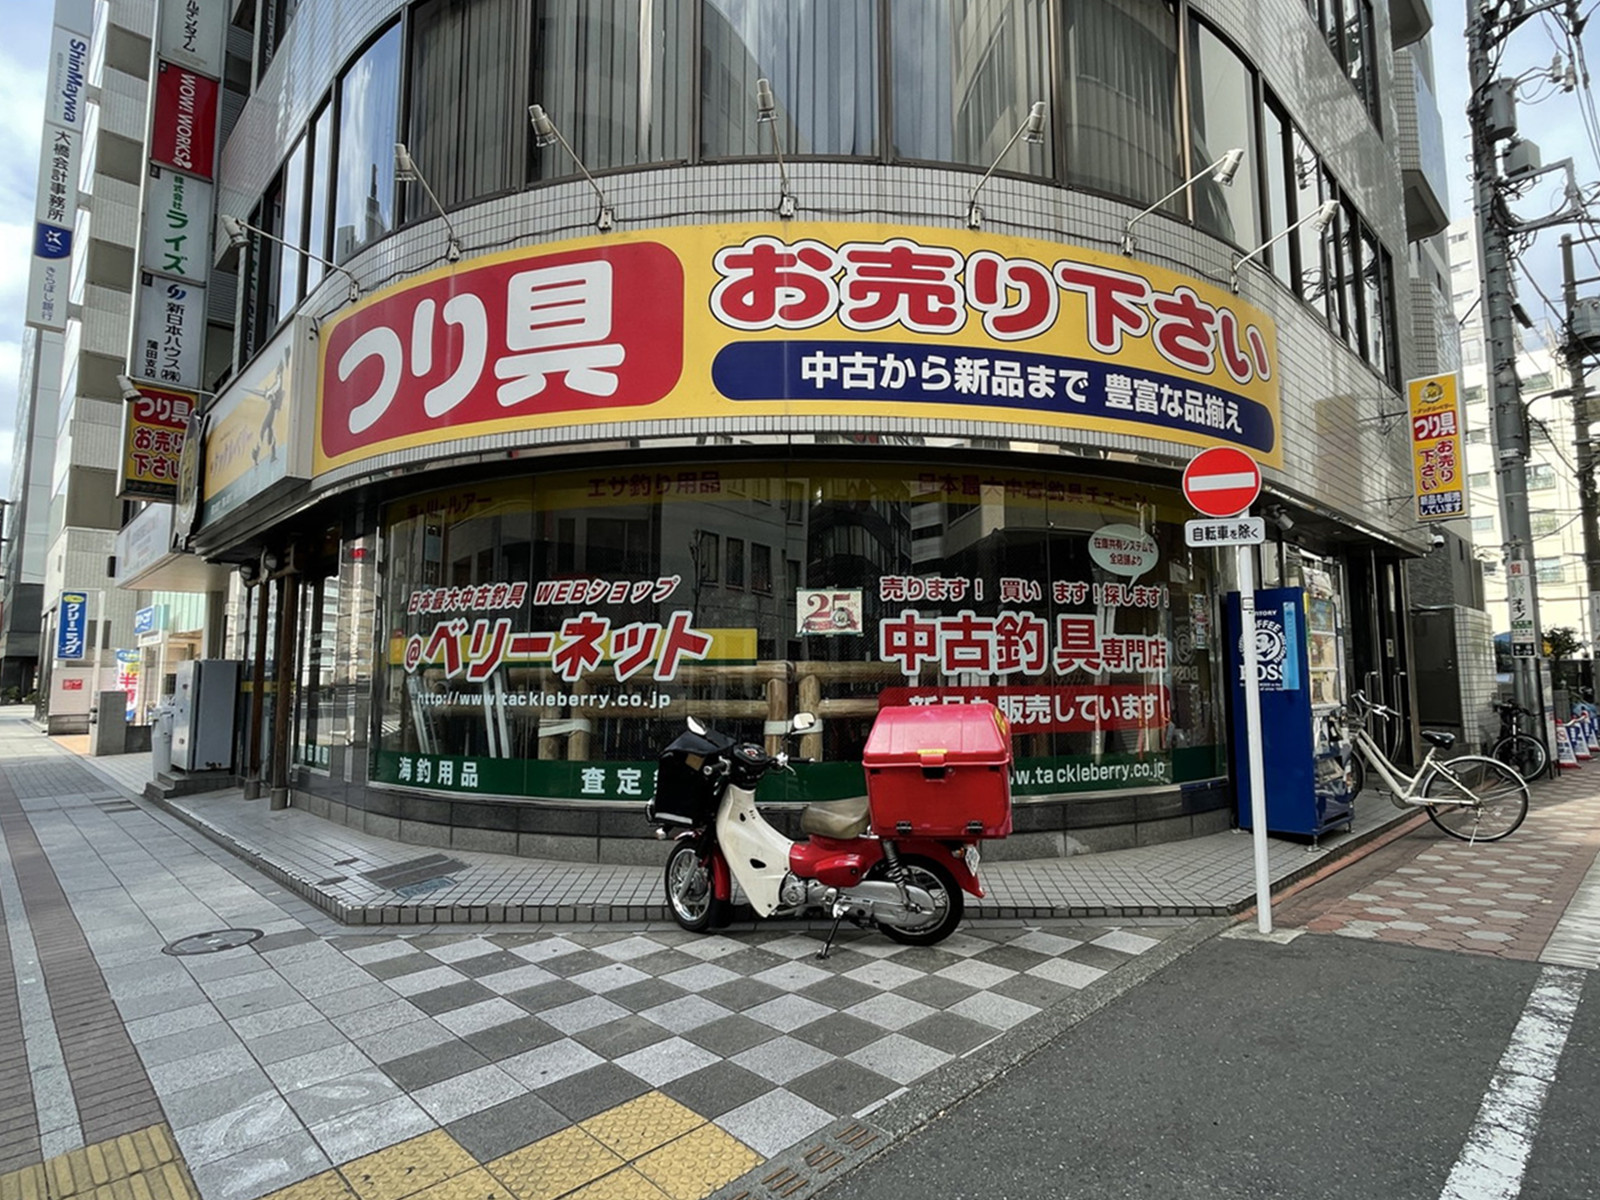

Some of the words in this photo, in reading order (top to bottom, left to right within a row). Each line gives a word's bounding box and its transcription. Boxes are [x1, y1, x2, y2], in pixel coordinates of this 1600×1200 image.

[62, 39, 87, 123] ShinMaywa
[178, 73, 197, 113] WOW!
[174, 114, 193, 160] WORKS
[47, 131, 71, 222] 大橋会計事務所
[163, 209, 188, 274] ライズ
[709, 235, 1271, 384] お売り下さい
[338, 260, 626, 436] つり具
[137, 397, 190, 425] つり具
[801, 350, 1088, 403] 中古から新品まで
[1104, 373, 1243, 434] 豊富な品揃え
[1414, 411, 1456, 439] つり具
[1419, 449, 1438, 491] 下さい
[1437, 440, 1456, 482] お売り
[587, 471, 722, 499] エサ釣り用品
[1420, 503, 1461, 516] しています
[1192, 525, 1259, 542] 自転車を除く
[407, 582, 528, 615] 日本最大中古釣具
[533, 574, 682, 606] WEBショップ
[1255, 619, 1282, 634] FFEE
[404, 611, 714, 683] @ベリーネット
[416, 691, 672, 709] http://www.tackleberry.co.jp
[398, 757, 480, 788] 海釣用品
[581, 767, 658, 796] 査定
[1010, 759, 1166, 785] w.tackleberry.co.jp
